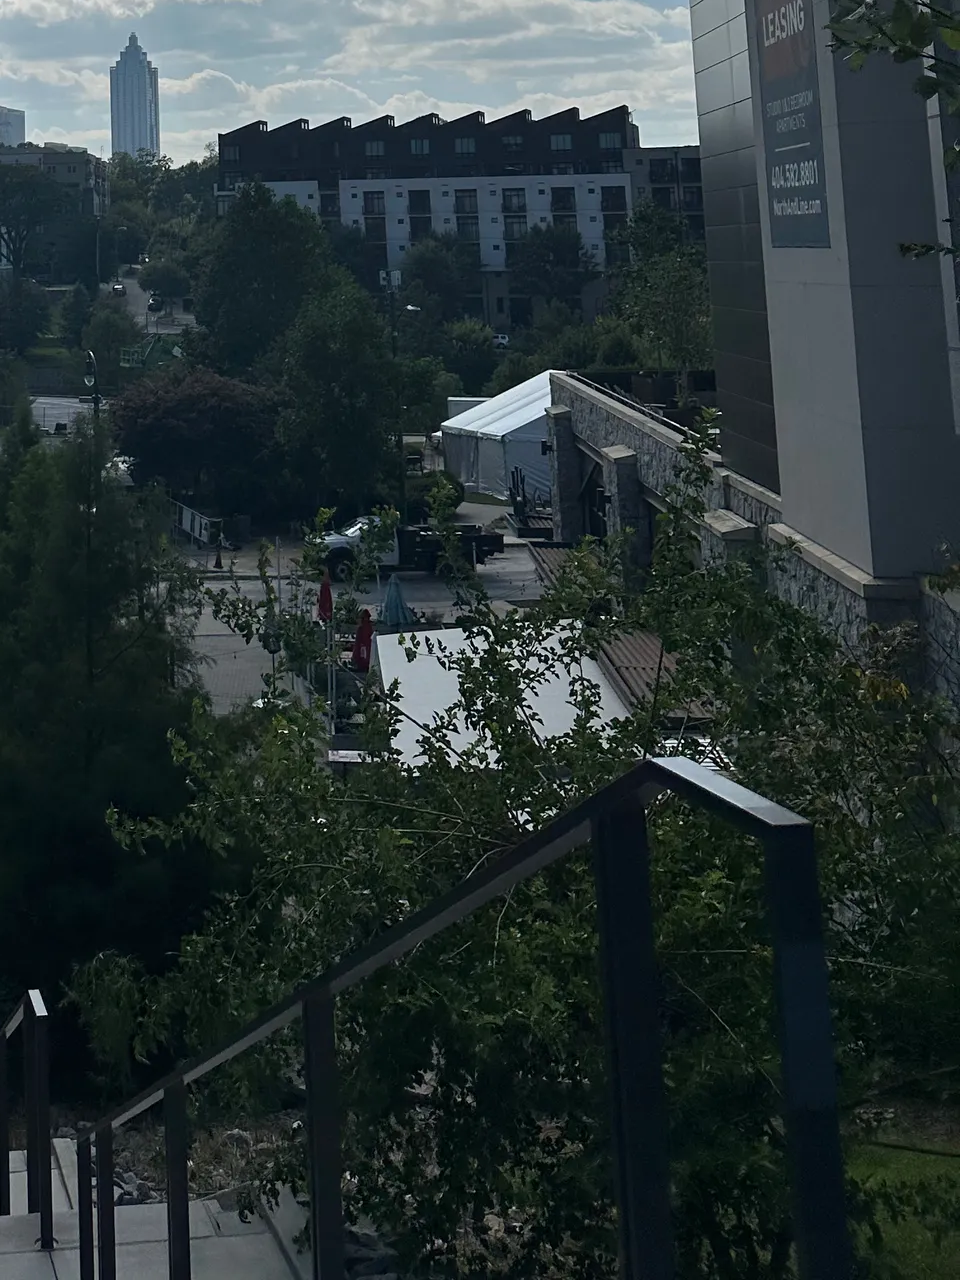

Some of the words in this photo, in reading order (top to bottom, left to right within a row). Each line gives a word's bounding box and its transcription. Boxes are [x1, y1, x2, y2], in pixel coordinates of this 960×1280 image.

[775, 112, 806, 133] APARTMENTS
[771, 159, 819, 189] 404.582.8801
[773, 195, 822, 216] NorthAndLine.com
